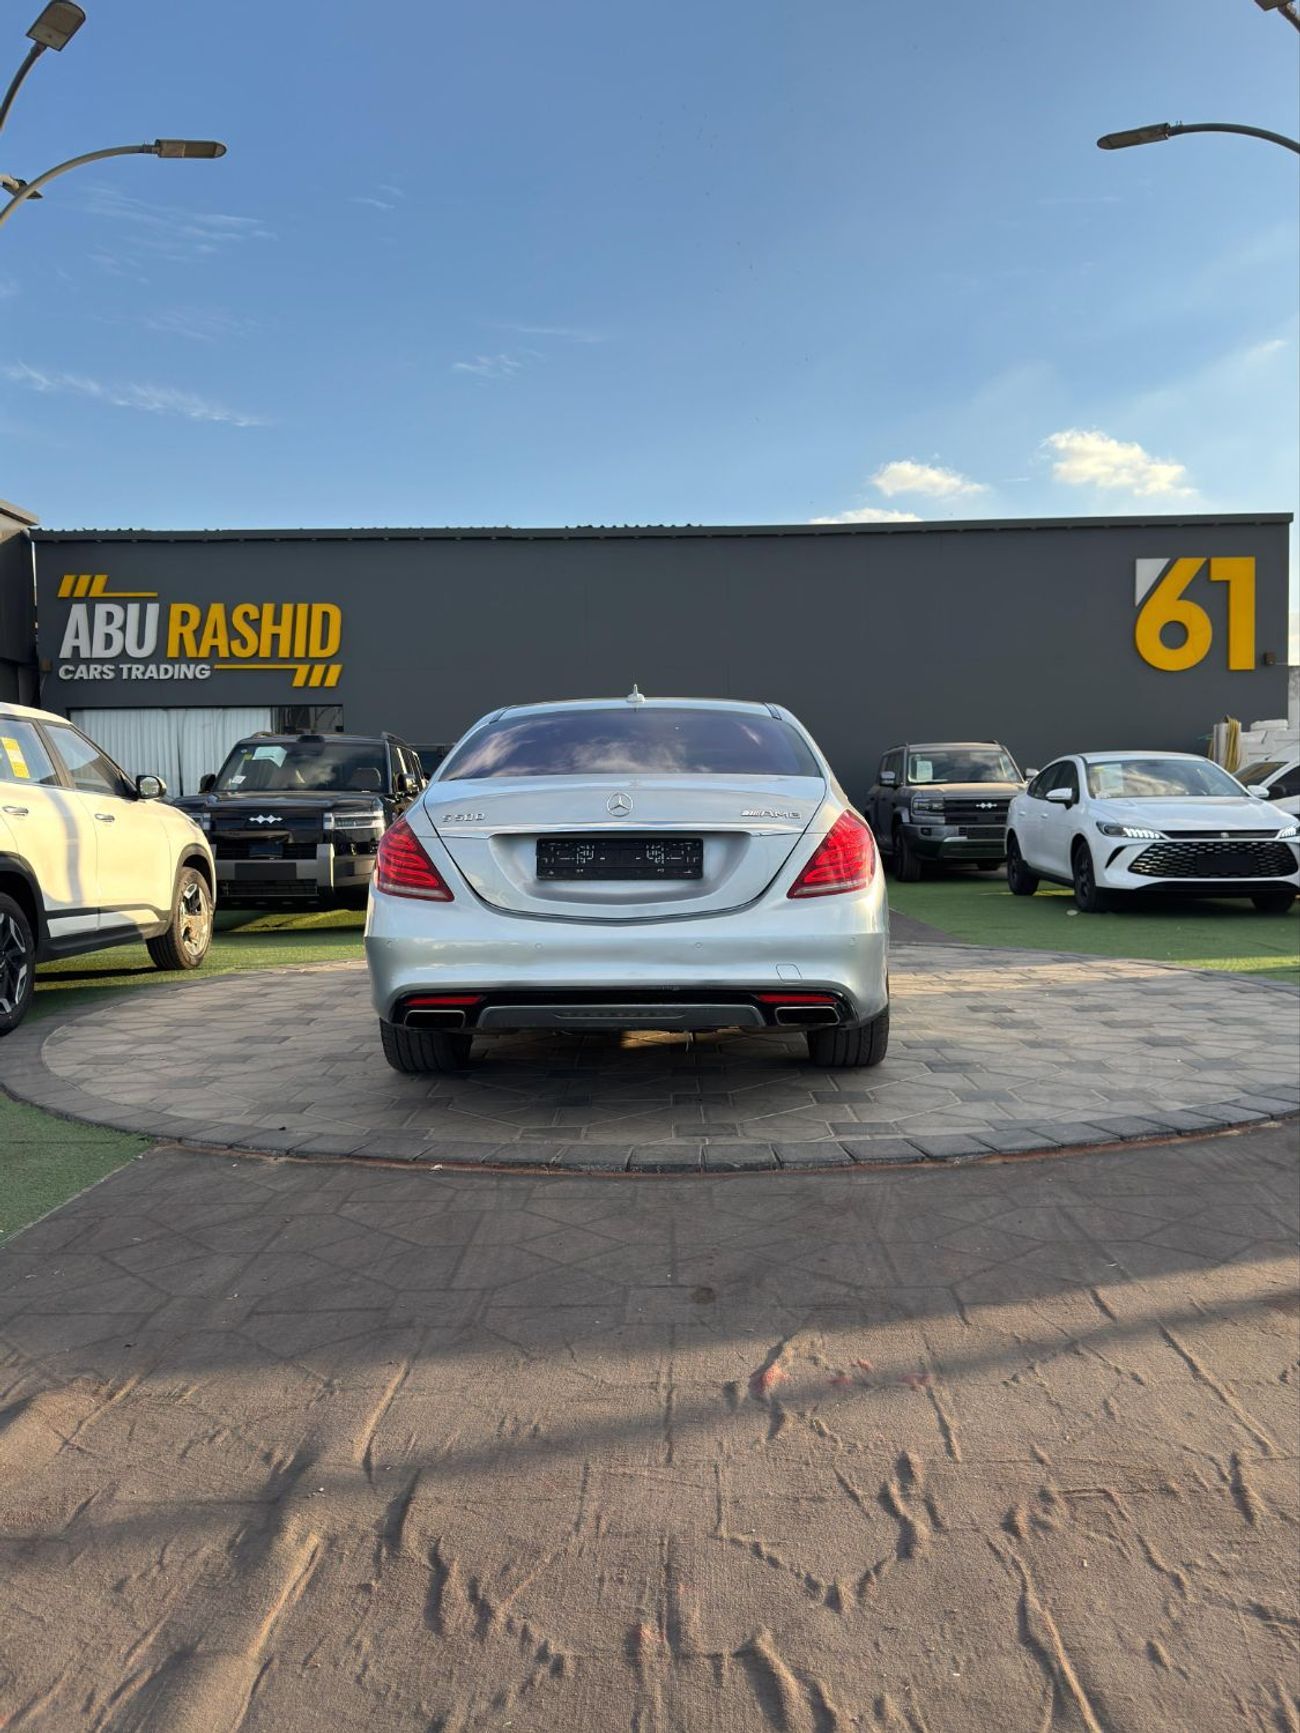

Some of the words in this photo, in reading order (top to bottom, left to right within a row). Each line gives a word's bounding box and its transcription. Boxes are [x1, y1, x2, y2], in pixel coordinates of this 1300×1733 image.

[59, 603, 160, 658] ABU
[166, 603, 342, 658] RASHID
[1135, 557, 1255, 671] 61
[58, 664, 115, 680] CARS
[119, 664, 212, 680] TRADING
